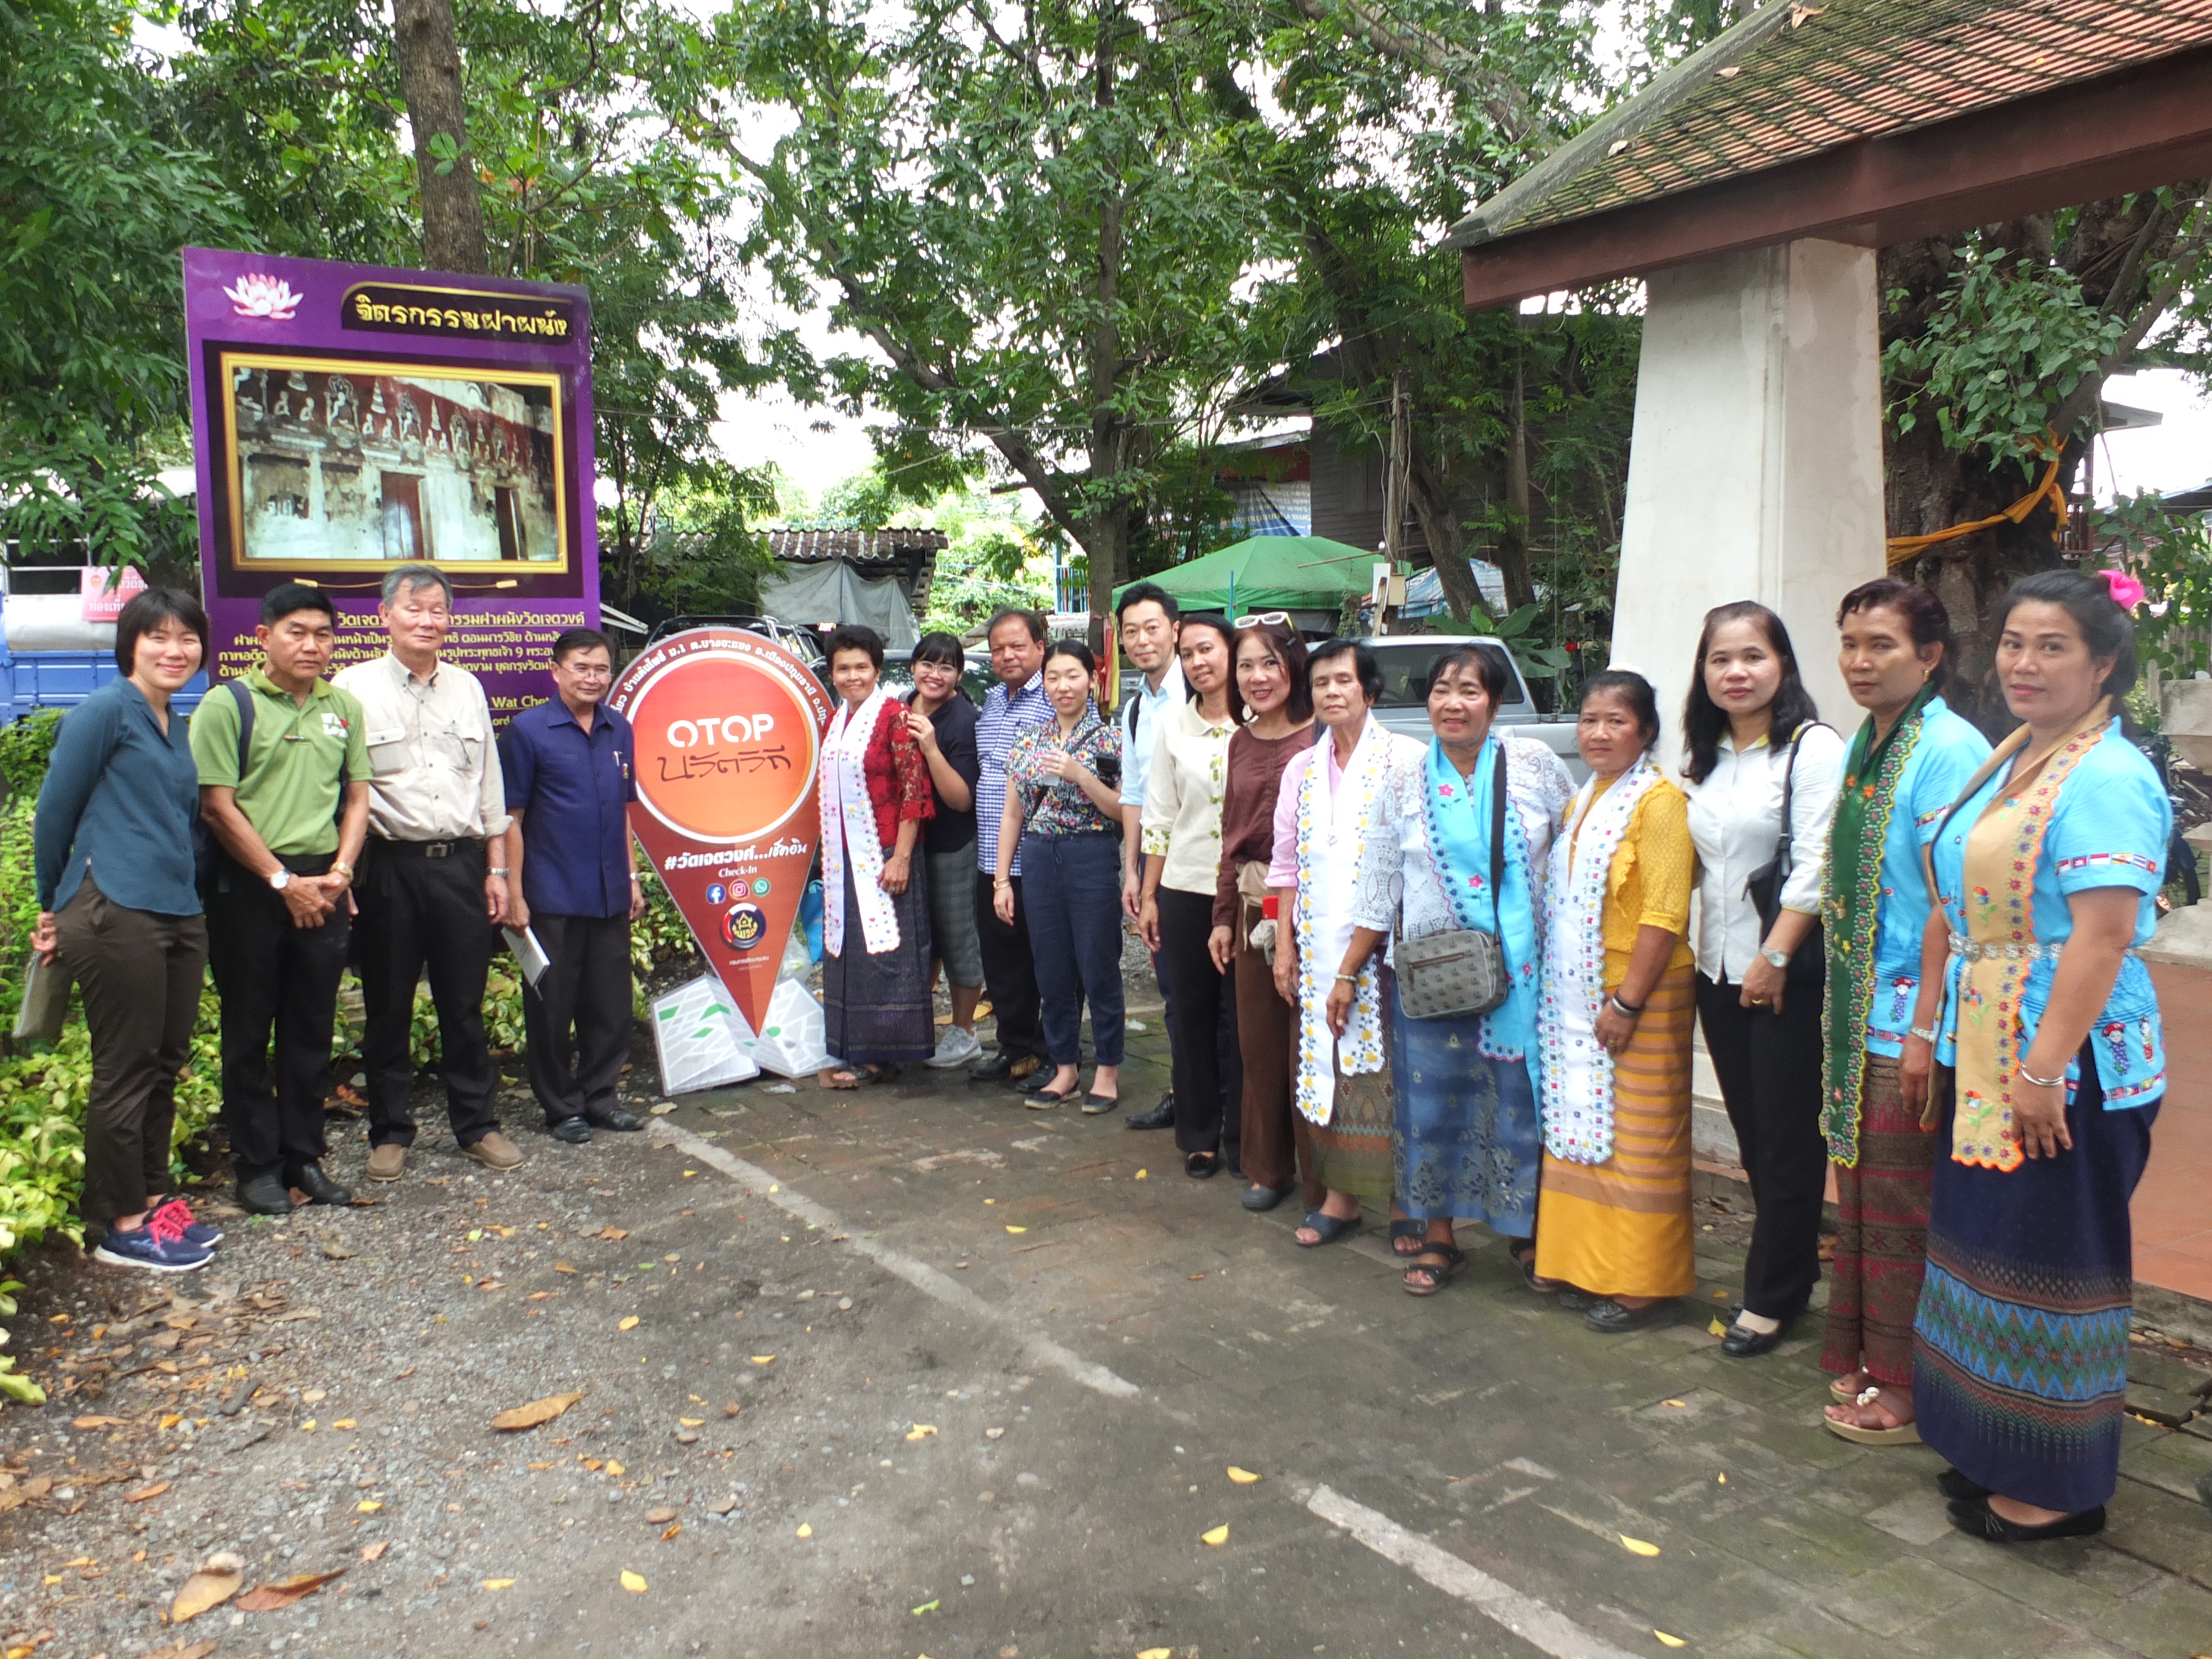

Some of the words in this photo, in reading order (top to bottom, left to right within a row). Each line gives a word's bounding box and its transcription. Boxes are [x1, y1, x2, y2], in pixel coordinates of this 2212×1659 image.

[354, 293, 568, 336] จิตรกรรมฝาผนัง
[234, 634, 265, 646] ฝาผ
[515, 646, 524, 658] 9
[491, 696, 518, 708] Wat
[667, 713, 775, 748] OTOP
